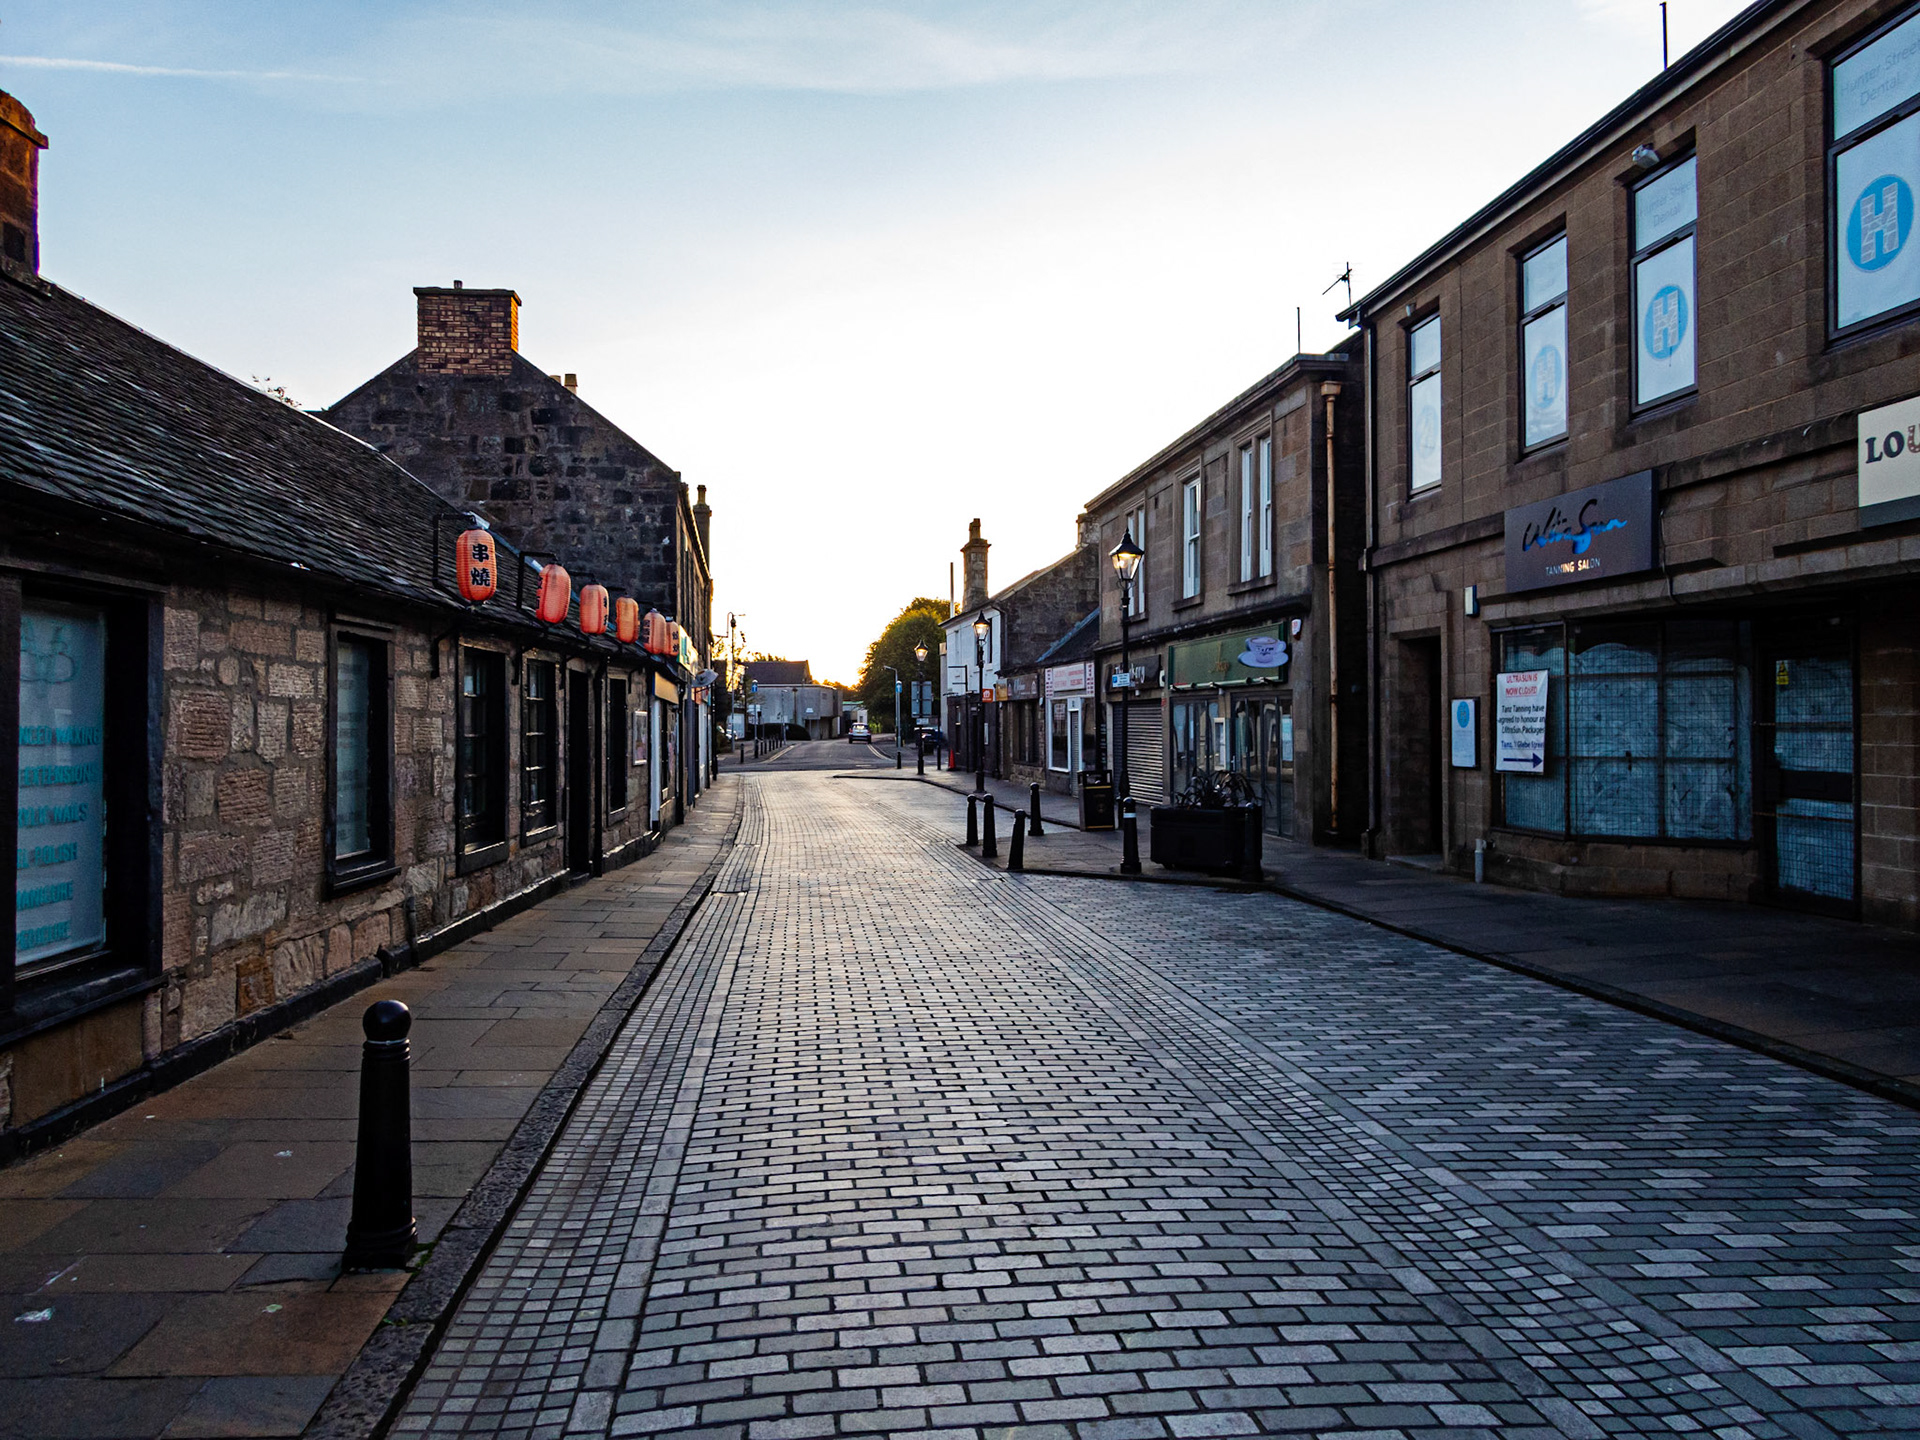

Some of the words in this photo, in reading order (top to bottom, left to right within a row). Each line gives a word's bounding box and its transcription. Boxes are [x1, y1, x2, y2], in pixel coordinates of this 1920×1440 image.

[1840, 64, 1881, 97] Hunter
[1859, 72, 1901, 107] Dental
[1545, 561, 1575, 576] TANNING
[1577, 557, 1601, 571] SALON
[1506, 674, 1532, 683] ULTRASUN
[1533, 673, 1538, 682] IS
[1506, 687, 1518, 695] NOW
[1519, 686, 1537, 695] CLOSED
[1513, 705, 1531, 714] Tanning
[1532, 703, 1545, 712] have
[1498, 715, 1514, 725] agreed
[1520, 715, 1538, 723] honour
[35, 842, 78, 867] POLISH
